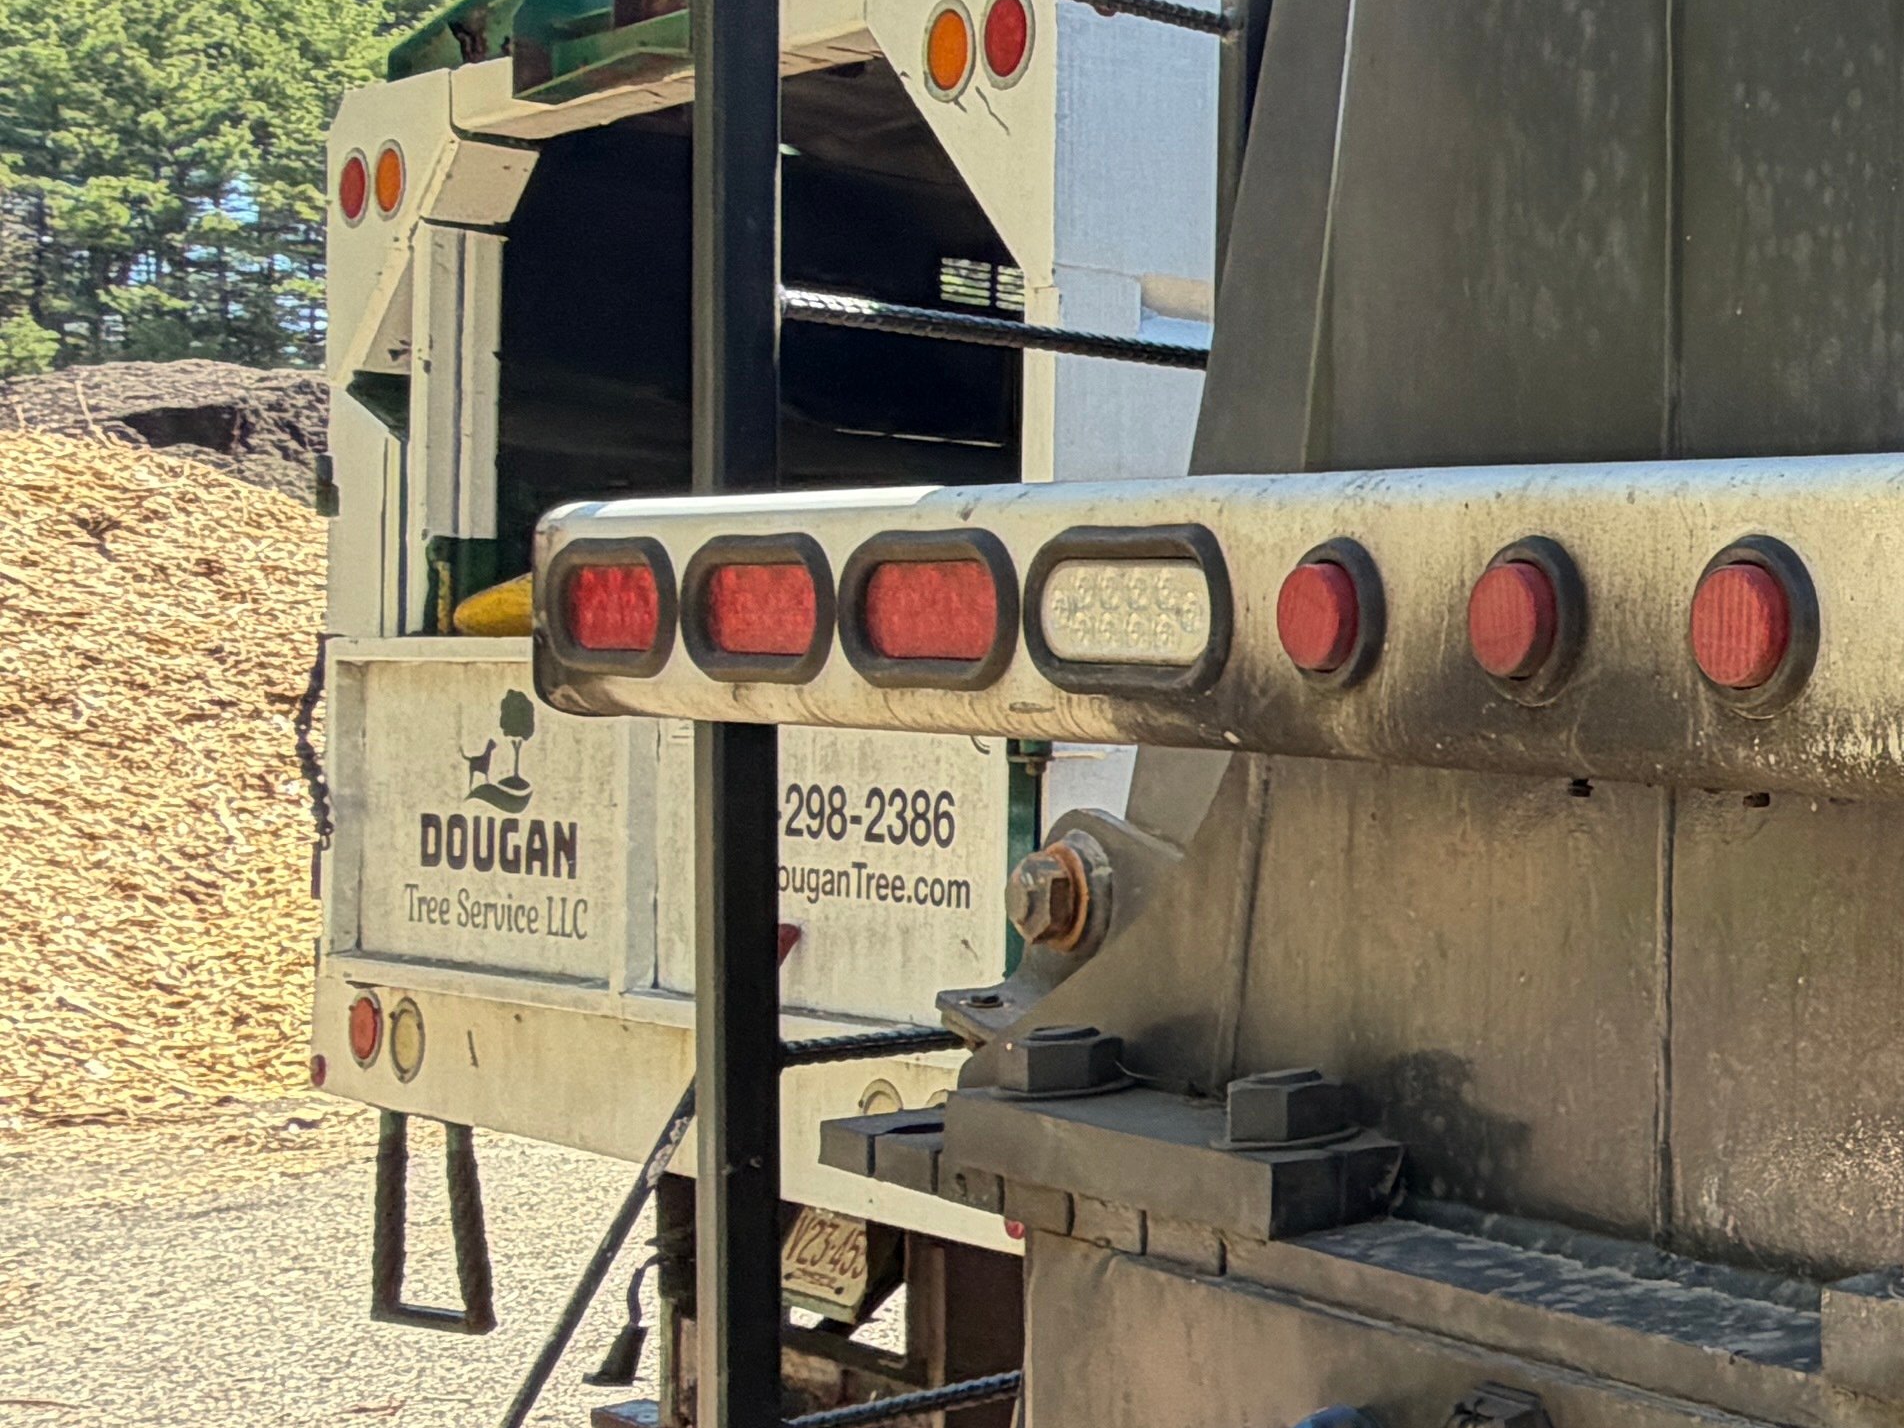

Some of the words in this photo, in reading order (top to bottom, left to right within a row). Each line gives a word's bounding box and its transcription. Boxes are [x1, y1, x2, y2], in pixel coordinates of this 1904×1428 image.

[420, 812, 578, 880] DOUGAN
[778, 783, 956, 848] 298-2386
[404, 883, 450, 925] Tree
[457, 887, 539, 935] Service
[546, 895, 588, 940] LLC
[778, 861, 971, 909] ouganTree.com
